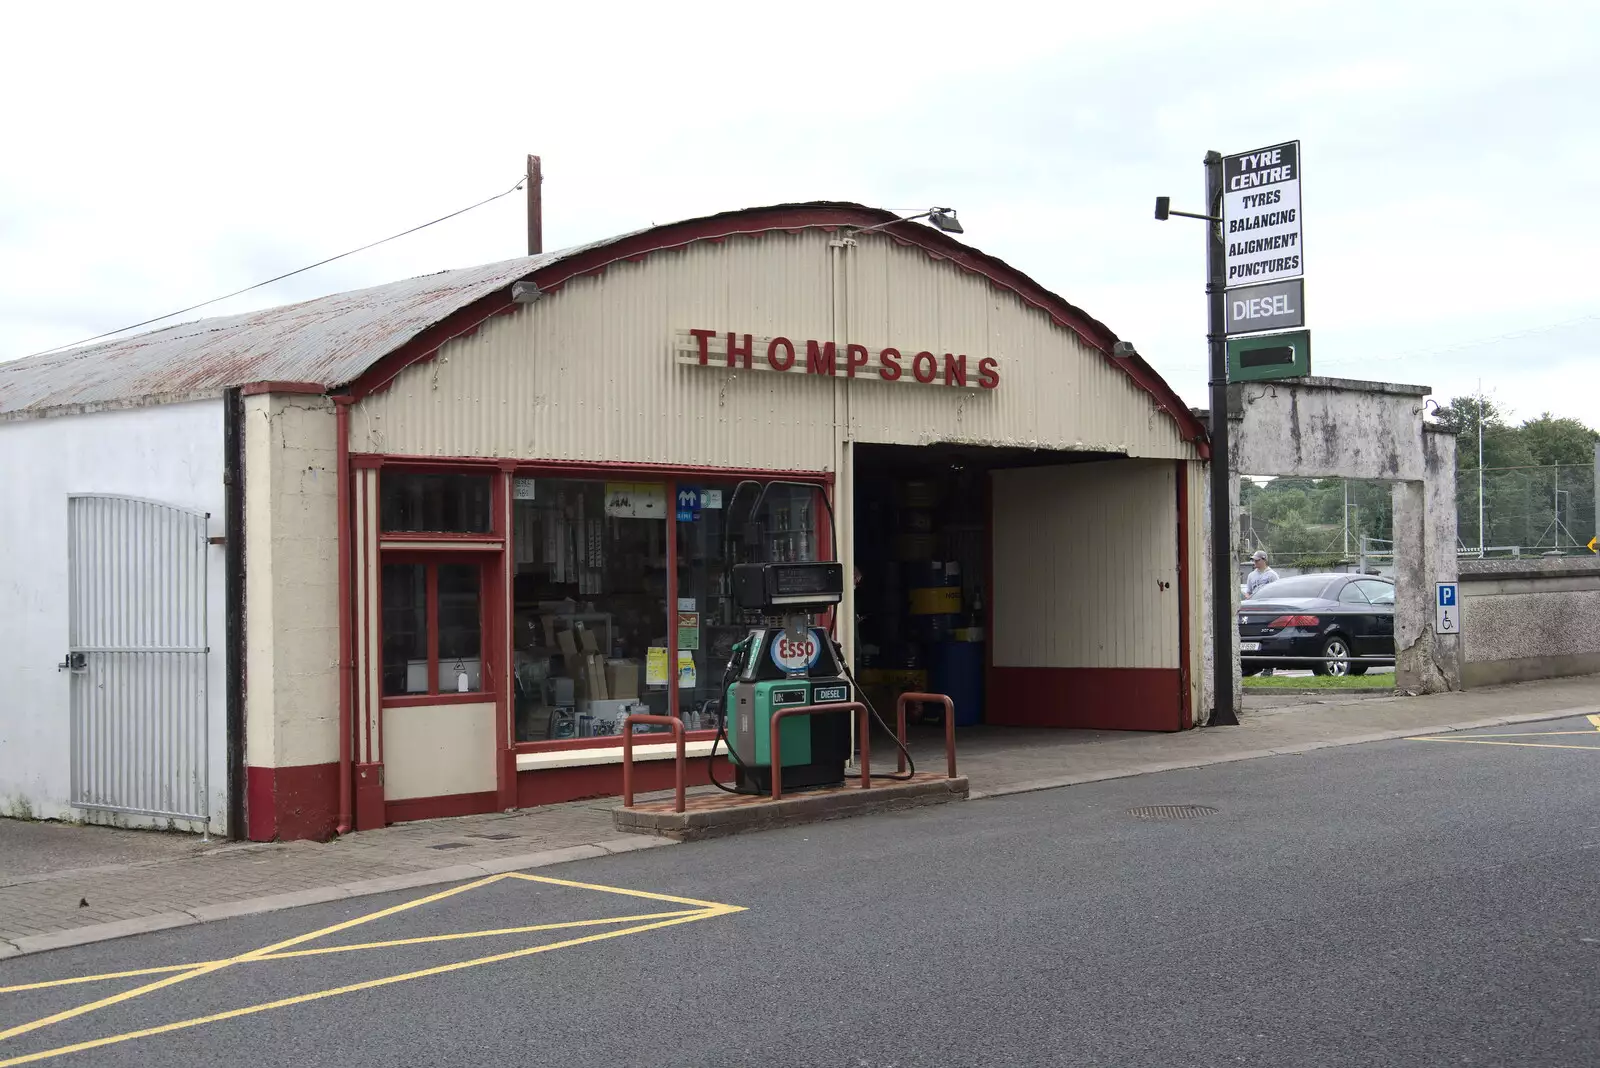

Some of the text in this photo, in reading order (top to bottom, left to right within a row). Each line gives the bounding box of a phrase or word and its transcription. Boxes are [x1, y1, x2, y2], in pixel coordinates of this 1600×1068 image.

[1240, 149, 1281, 171] TYRE
[1230, 165, 1291, 190] CENTRE
[1243, 190, 1281, 209] TYRES
[1229, 209, 1296, 233] BALANCING
[1229, 232, 1298, 256] ALIGNMENT
[1229, 255, 1299, 279] PUNCTURES
[1233, 294, 1295, 321] DIESEL
[690, 328, 1000, 389] THOMPSONS
[1443, 587, 1452, 605] P
[820, 689, 841, 699] DIESEL
